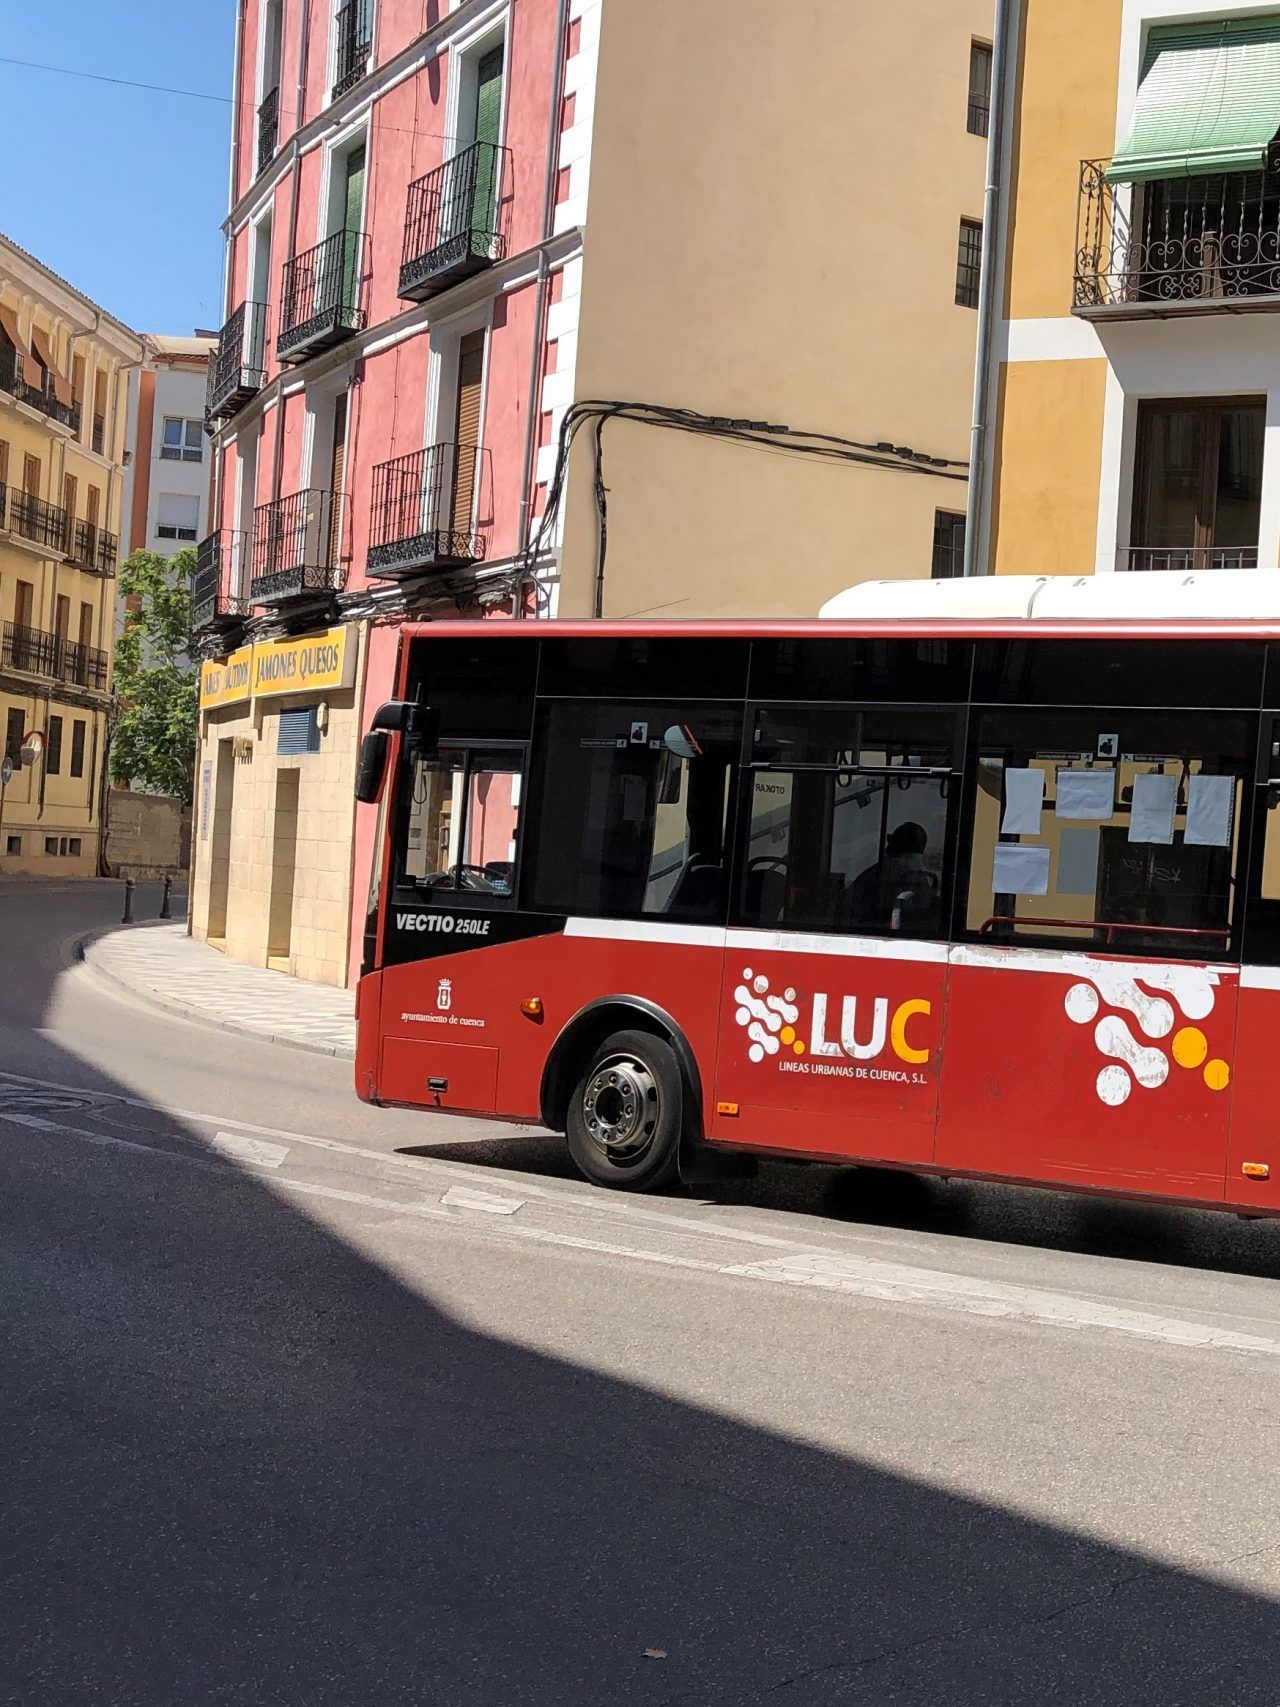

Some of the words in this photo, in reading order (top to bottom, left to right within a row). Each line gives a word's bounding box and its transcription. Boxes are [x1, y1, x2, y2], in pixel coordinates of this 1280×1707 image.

[255, 650, 297, 688] JAMONES
[300, 643, 339, 680] QUESOS
[396, 913, 455, 933] VECTIO
[455, 918, 491, 935] 250LE
[401, 1012, 448, 1024] ayuntamiento
[448, 1014, 458, 1025] de
[460, 1017, 485, 1027] cuenca
[810, 992, 931, 1064] LUC
[779, 1061, 809, 1073] LINEAS
[811, 1063, 855, 1078] URBANAS
[855, 1068, 868, 1079] DE
[869, 1070, 911, 1084] CUENCA,
[912, 1072, 928, 1084] S.L.
